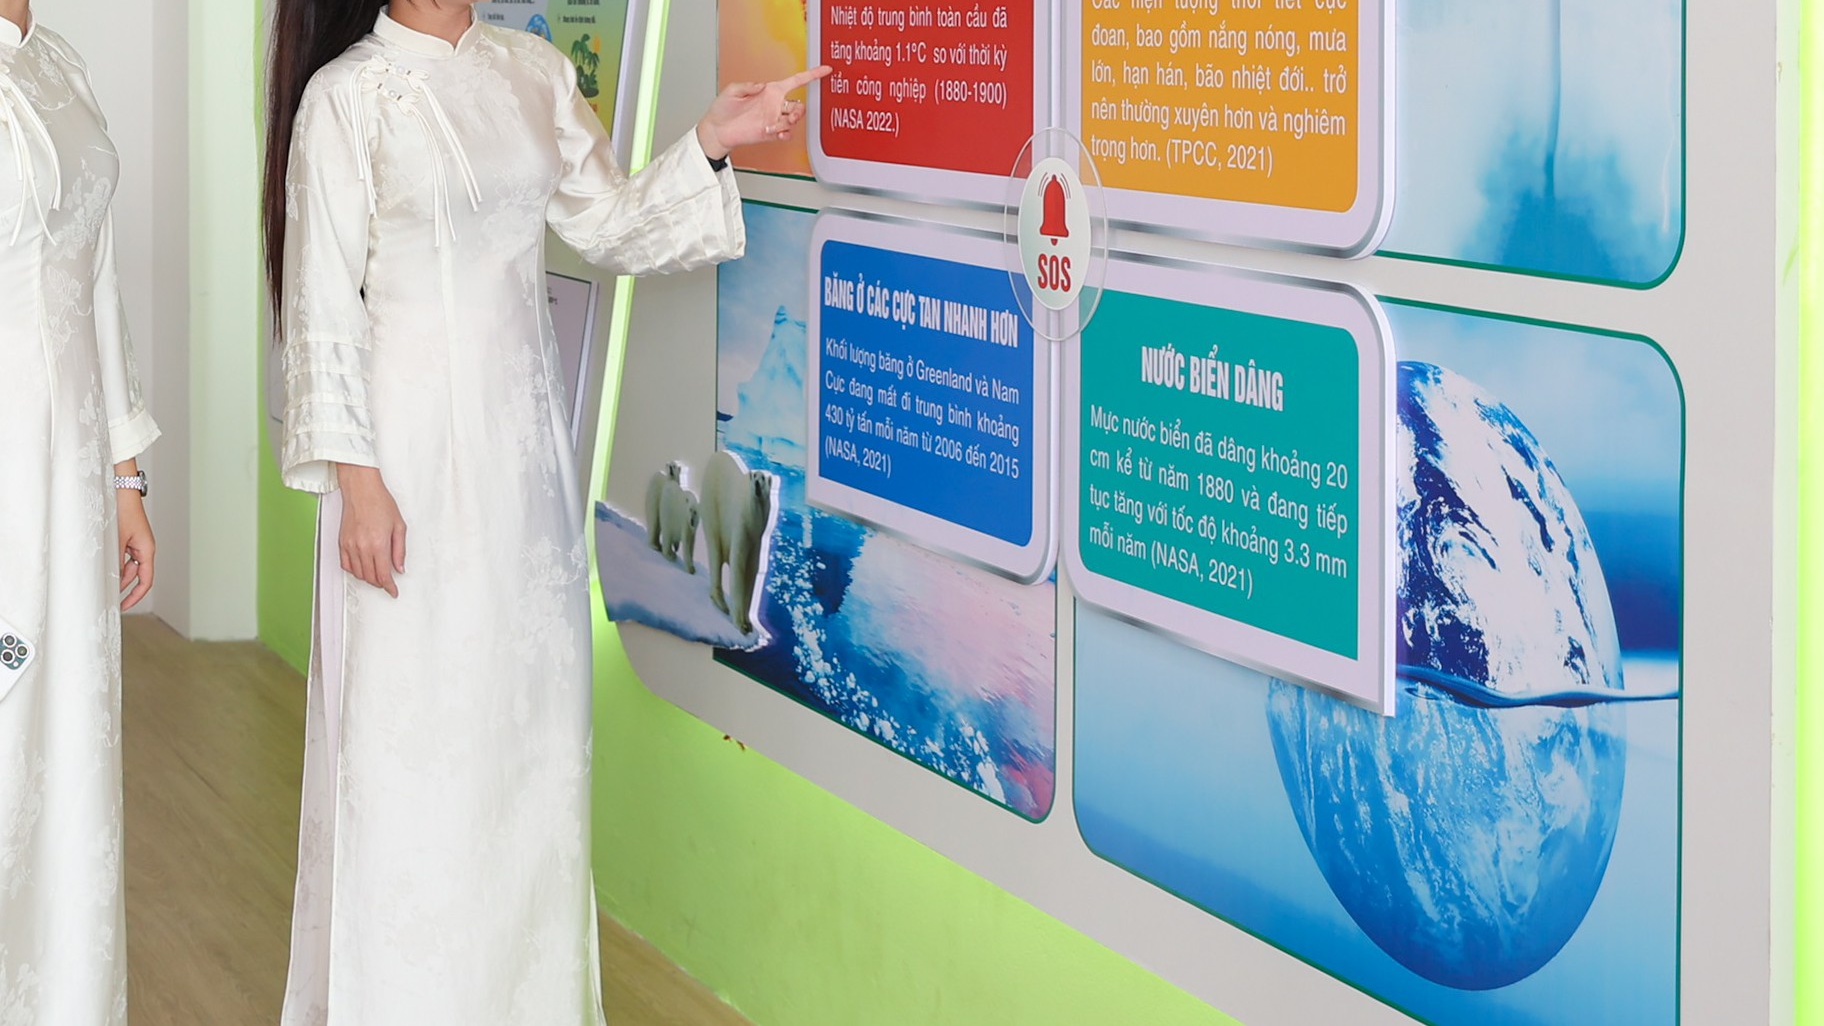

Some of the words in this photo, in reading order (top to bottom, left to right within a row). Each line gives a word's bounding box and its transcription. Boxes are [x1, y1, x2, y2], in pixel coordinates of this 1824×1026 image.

[830, 5, 857, 28] Nhiệt
[860, 5, 873, 29] độ
[877, 7, 904, 31] trung
[909, 5, 932, 26] bình
[936, 5, 961, 27] toàn
[992, 6, 1007, 27] đã
[1091, 23, 1129, 49] đoan,
[1136, 23, 1163, 46] bao
[1169, 20, 1200, 53] gồm
[1208, 20, 1247, 55] nắng
[1255, 24, 1300, 56] nóng,
[1309, 28, 1346, 51] mưa
[830, 40, 851, 64] tăng
[854, 38, 891, 66] khoảng
[933, 47, 946, 63] so
[949, 42, 965, 64] với
[968, 43, 990, 65] thời
[993, 43, 1007, 71] kỳ
[856, 75, 881, 101] công
[889, 77, 926, 103] nghiệp
[934, 79, 1006, 109] (1880-1900)
[1091, 59, 1115, 83] lớn,
[1123, 60, 1148, 88] hạn
[1156, 61, 1187, 87] hán,
[1195, 62, 1224, 88] bão
[1231, 64, 1271, 94] nhiệt
[1323, 64, 1346, 93] trở
[830, 107, 863, 130] (NASA
[866, 110, 898, 136] 2022.)
[1091, 97, 1116, 119] nên
[1120, 98, 1169, 130] thường
[1173, 102, 1218, 131] xuyên
[1224, 104, 1253, 129] hơn
[1258, 105, 1278, 131] và
[1283, 107, 1345, 139] nghiêm
[1090, 134, 1126, 164] trọng
[1130, 136, 1160, 161] hơn.
[1226, 143, 1272, 177] 2021)
[1037, 253, 1072, 293] SOS
[824, 272, 854, 311] BĂNG
[866, 280, 889, 319] CÁC
[892, 289, 915, 329] CỰC
[918, 295, 941, 330] TAN
[943, 300, 987, 341] NHANH
[990, 305, 1020, 348] HƠN
[826, 338, 847, 359] Khối
[849, 343, 875, 372] lượng
[878, 350, 903, 380] băng
[915, 359, 972, 392] Greenland
[974, 375, 989, 397] và
[991, 378, 1019, 404] Nam
[1141, 342, 1185, 390] NƯỚC
[1189, 343, 1229, 400] BIỂN
[1234, 357, 1283, 411] DÂNG
[825, 370, 844, 394] Cực
[848, 377, 873, 405] đang
[877, 385, 896, 407] mất
[901, 391, 910, 410] đi
[915, 395, 942, 425] trung
[948, 403, 971, 427] bình
[977, 410, 1019, 447] khoảng
[824, 403, 843, 425] 430
[857, 411, 872, 433] tấn
[875, 417, 893, 440] mỗi
[896, 426, 918, 446] năm
[921, 431, 932, 451] từ
[934, 435, 962, 461] 2006
[965, 443, 986, 468] đến
[989, 451, 1019, 478] 2015
[825, 436, 859, 463] (NASA,
[862, 447, 890, 477] 2021)
[1090, 404, 1118, 434] Mực
[1122, 416, 1155, 441] nước
[1159, 419, 1189, 449] biển
[1194, 430, 1213, 456] đã
[1217, 435, 1255, 472] dâng
[1261, 445, 1320, 487] khoảng
[1326, 461, 1347, 489] 20
[1089, 449, 1109, 468] cm
[1116, 447, 1132, 475] kể
[1138, 457, 1152, 480] từ
[1158, 464, 1188, 490] năm
[1197, 472, 1233, 503] 1880
[1241, 485, 1260, 510] và
[1267, 491, 1308, 529] đang
[1316, 502, 1347, 538] tiếp
[1089, 483, 1109, 511] tục
[1113, 490, 1142, 524] tăng
[1147, 501, 1167, 525] với
[1171, 505, 1193, 533] tốc
[1197, 514, 1216, 544] độ
[1221, 519, 1278, 563] khoảng
[1284, 538, 1309, 567] 3.3
[1315, 552, 1346, 577] mm
[1089, 521, 1113, 548] mỗi
[1117, 533, 1146, 559] năm
[1151, 540, 1203, 581] (NASA,
[1208, 558, 1252, 598] 2021)
